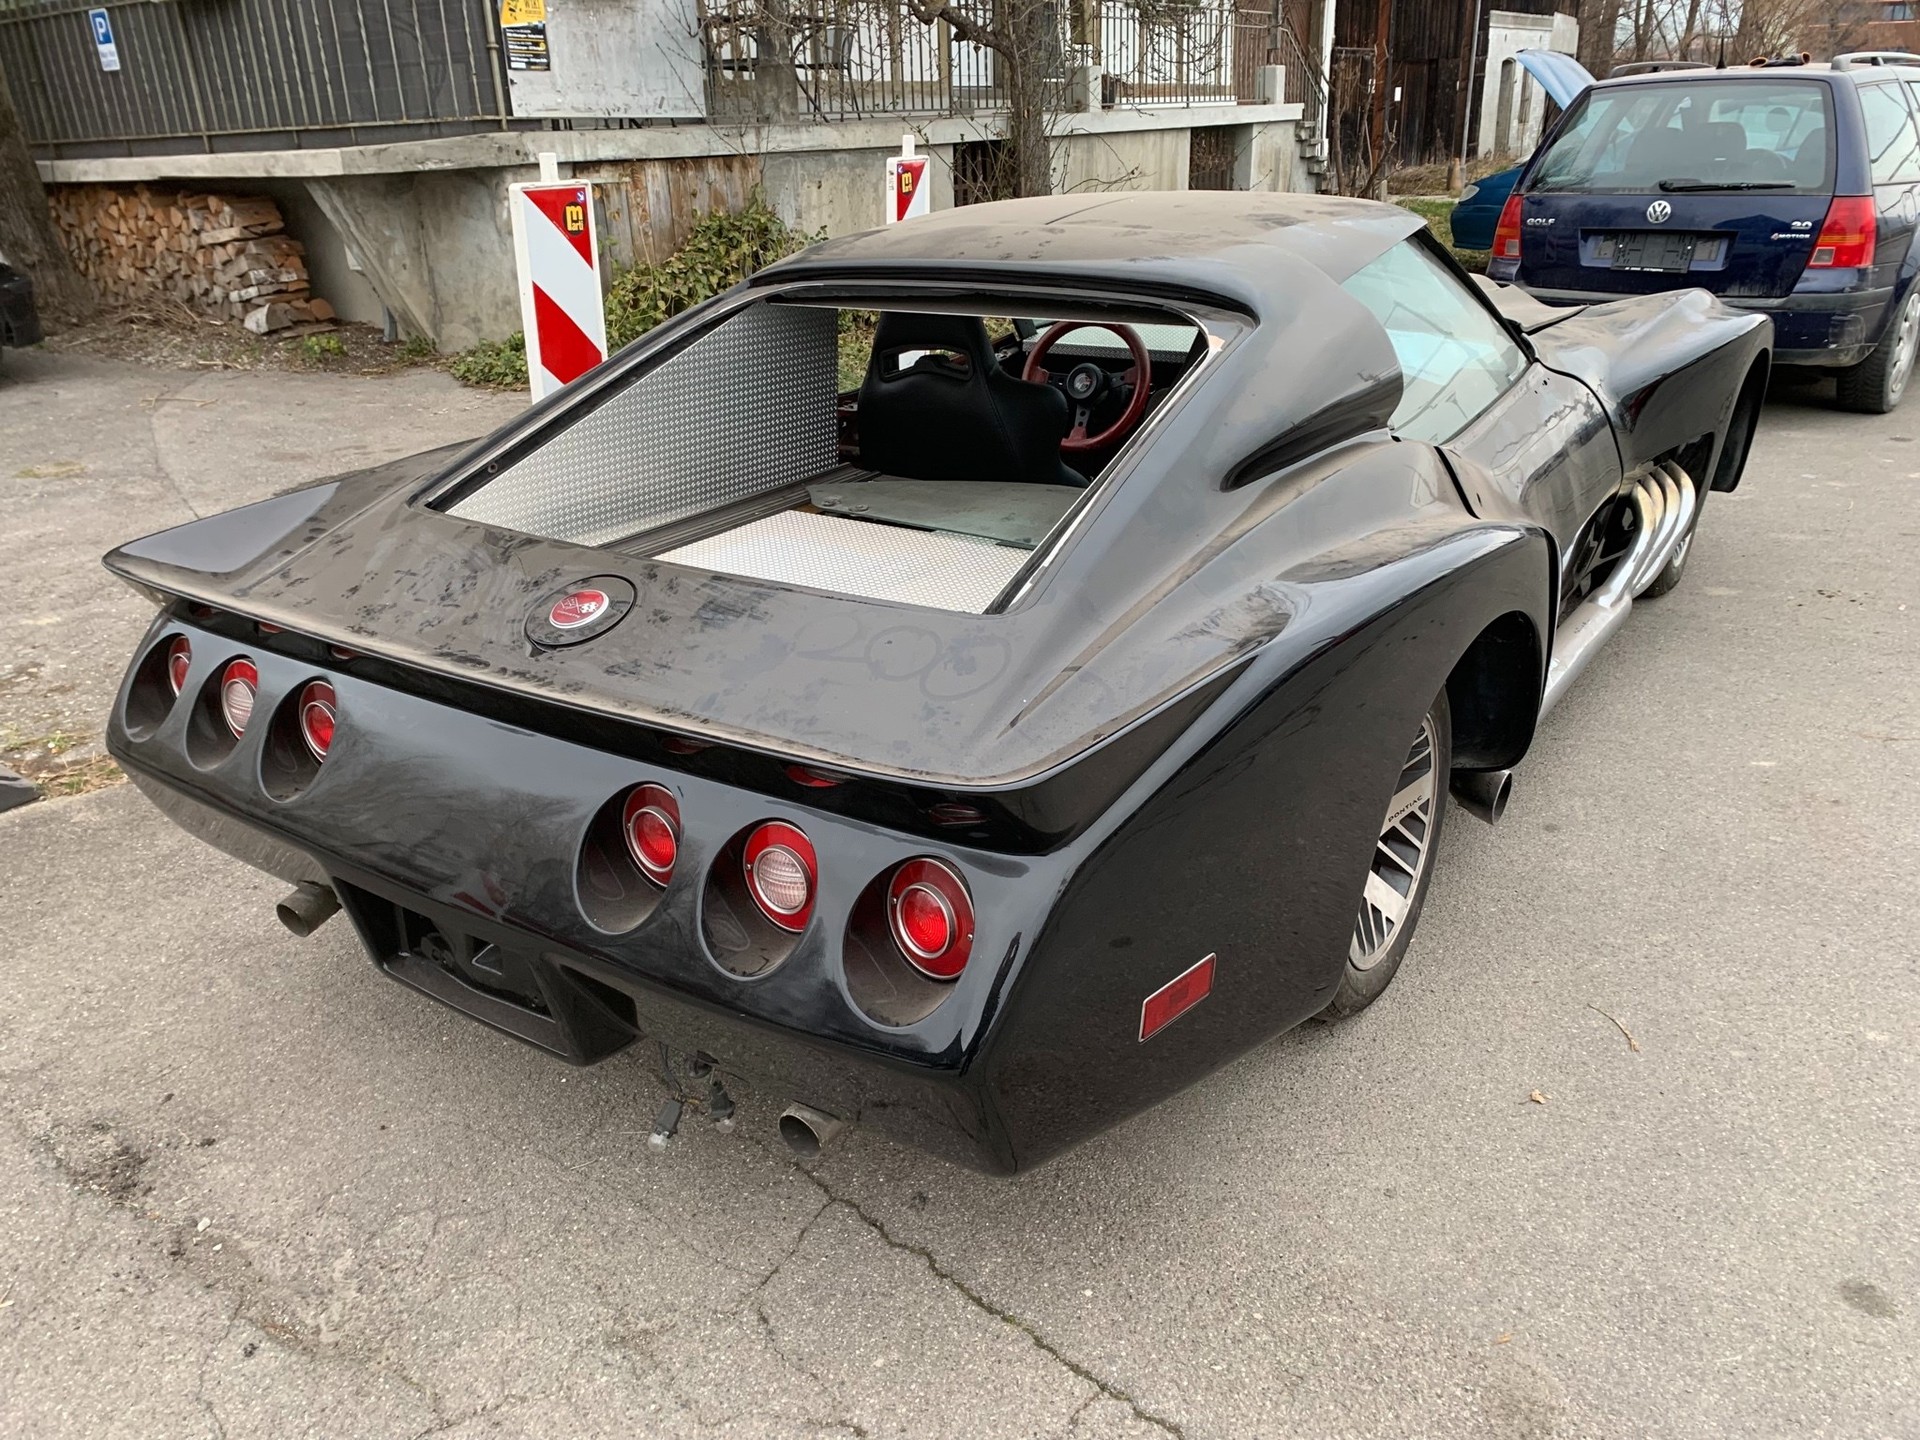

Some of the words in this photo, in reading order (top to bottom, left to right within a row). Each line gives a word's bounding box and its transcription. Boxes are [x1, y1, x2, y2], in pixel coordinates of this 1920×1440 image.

[95, 17, 106, 41] P
[1527, 218, 1555, 226] GOLF
[1387, 795, 1422, 822] PONTIAC
